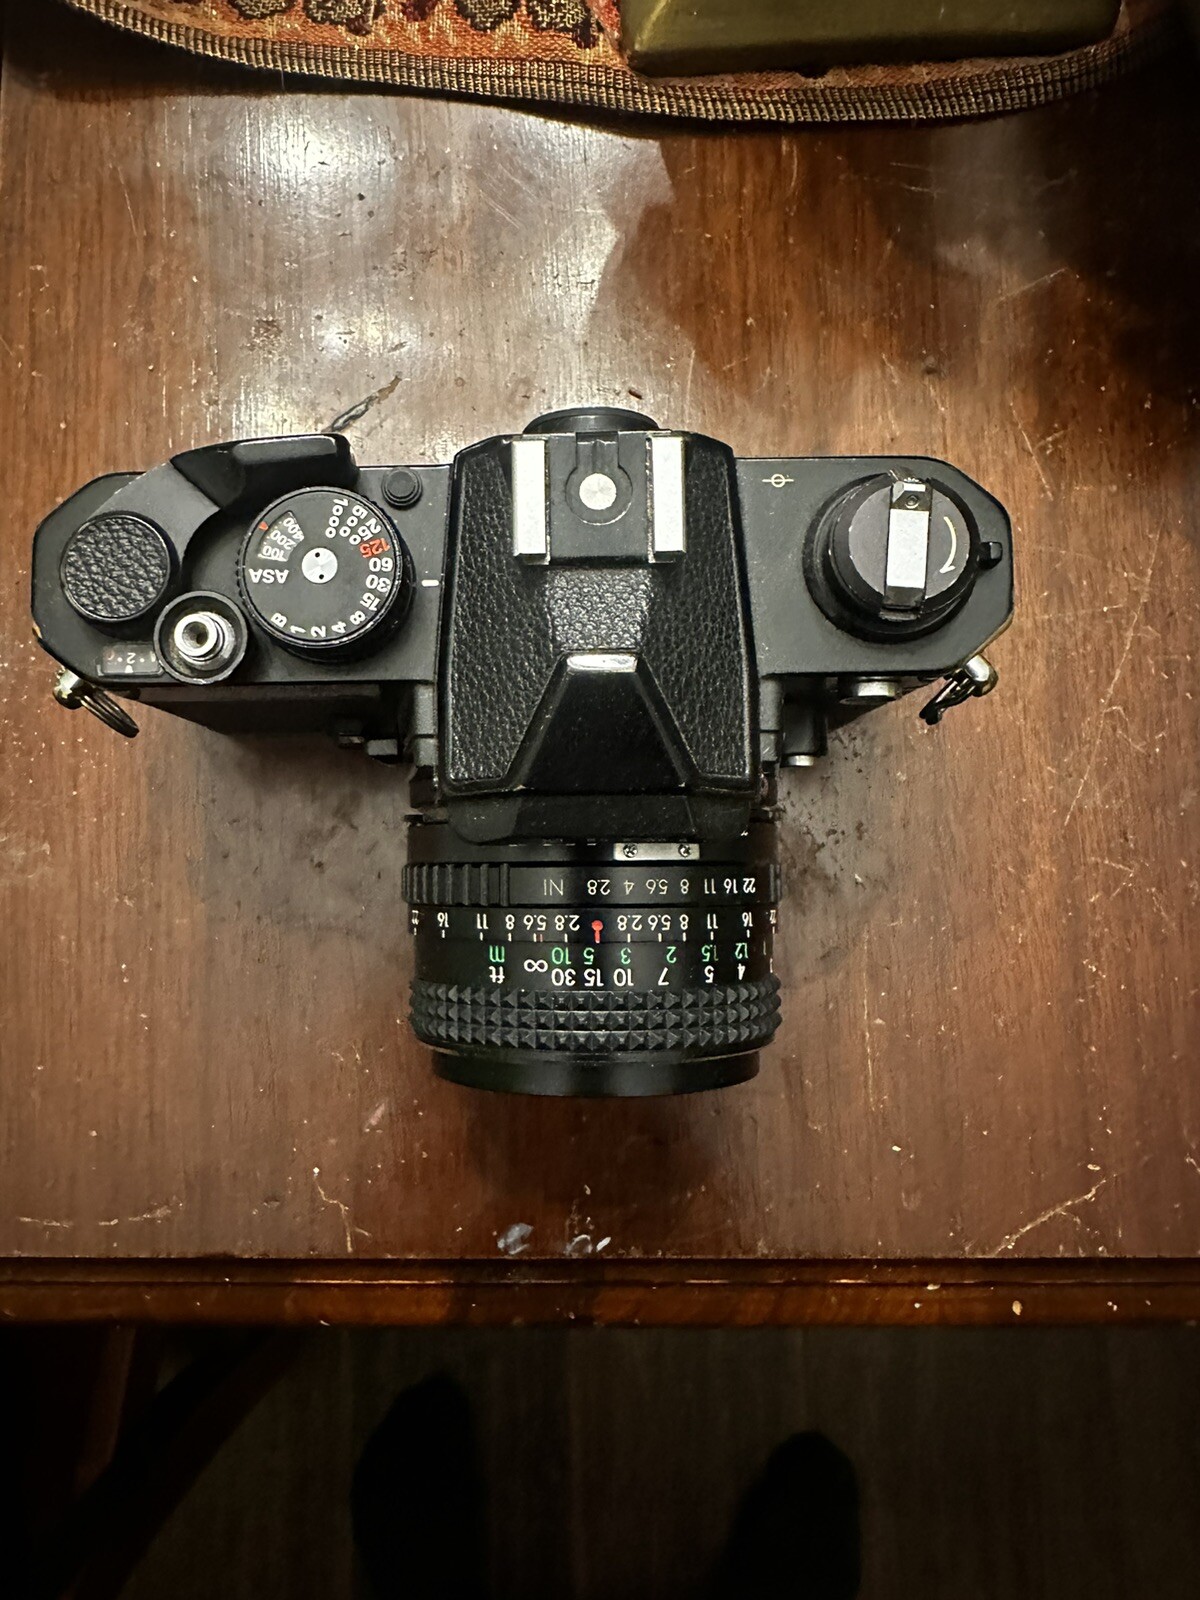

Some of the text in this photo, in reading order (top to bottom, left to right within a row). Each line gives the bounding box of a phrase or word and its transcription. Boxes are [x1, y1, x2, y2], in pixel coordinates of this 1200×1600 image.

[325, 498, 349, 538] 1000
[339, 504, 368, 537] 500
[270, 529, 297, 550] 200
[349, 517, 382, 545] 250
[262, 545, 285, 561] 100
[359, 537, 391, 558] 125
[368, 557, 393, 572] 60
[248, 568, 290, 584] ASA
[365, 574, 391, 593] 30
[359, 592, 382, 612] 15
[270, 612, 287, 628] B
[350, 610, 366, 626] 8
[290, 625, 307, 635] 1
[310, 625, 326, 638] 2
[331, 621, 347, 634] 4
[126, 652, 136, 664] 2
[586, 879, 611, 896] 2.8
[623, 879, 635, 896] 4
[645, 879, 669, 895] 5.6
[679, 878, 690, 895] 8
[703, 878, 717, 895] 11
[723, 878, 738, 895] 16
[742, 877, 756, 894] 22
[437, 912, 450, 928] 16
[476, 913, 489, 930] 11
[505, 914, 516, 931] 8
[523, 914, 547, 931] 5.6
[554, 914, 580, 931] 2.8
[616, 914, 642, 931] 2.8
[647, 914, 672, 931] 5.6
[679, 914, 689, 931] 8
[706, 913, 719, 930] 11
[741, 911, 753, 928] 16
[488, 945, 505, 963] m
[551, 946, 572, 965] 10
[583, 947, 595, 965] 5
[620, 947, 632, 965] 3
[665, 946, 677, 964] 2
[701, 944, 719, 962] 1.5
[488, 965, 505, 984] ft
[551, 968, 577, 987] 30
[583, 968, 604, 987] 15
[613, 968, 634, 987] 10
[657, 967, 670, 986] 7
[704, 965, 715, 984] 5
[737, 963, 746, 980] 4
